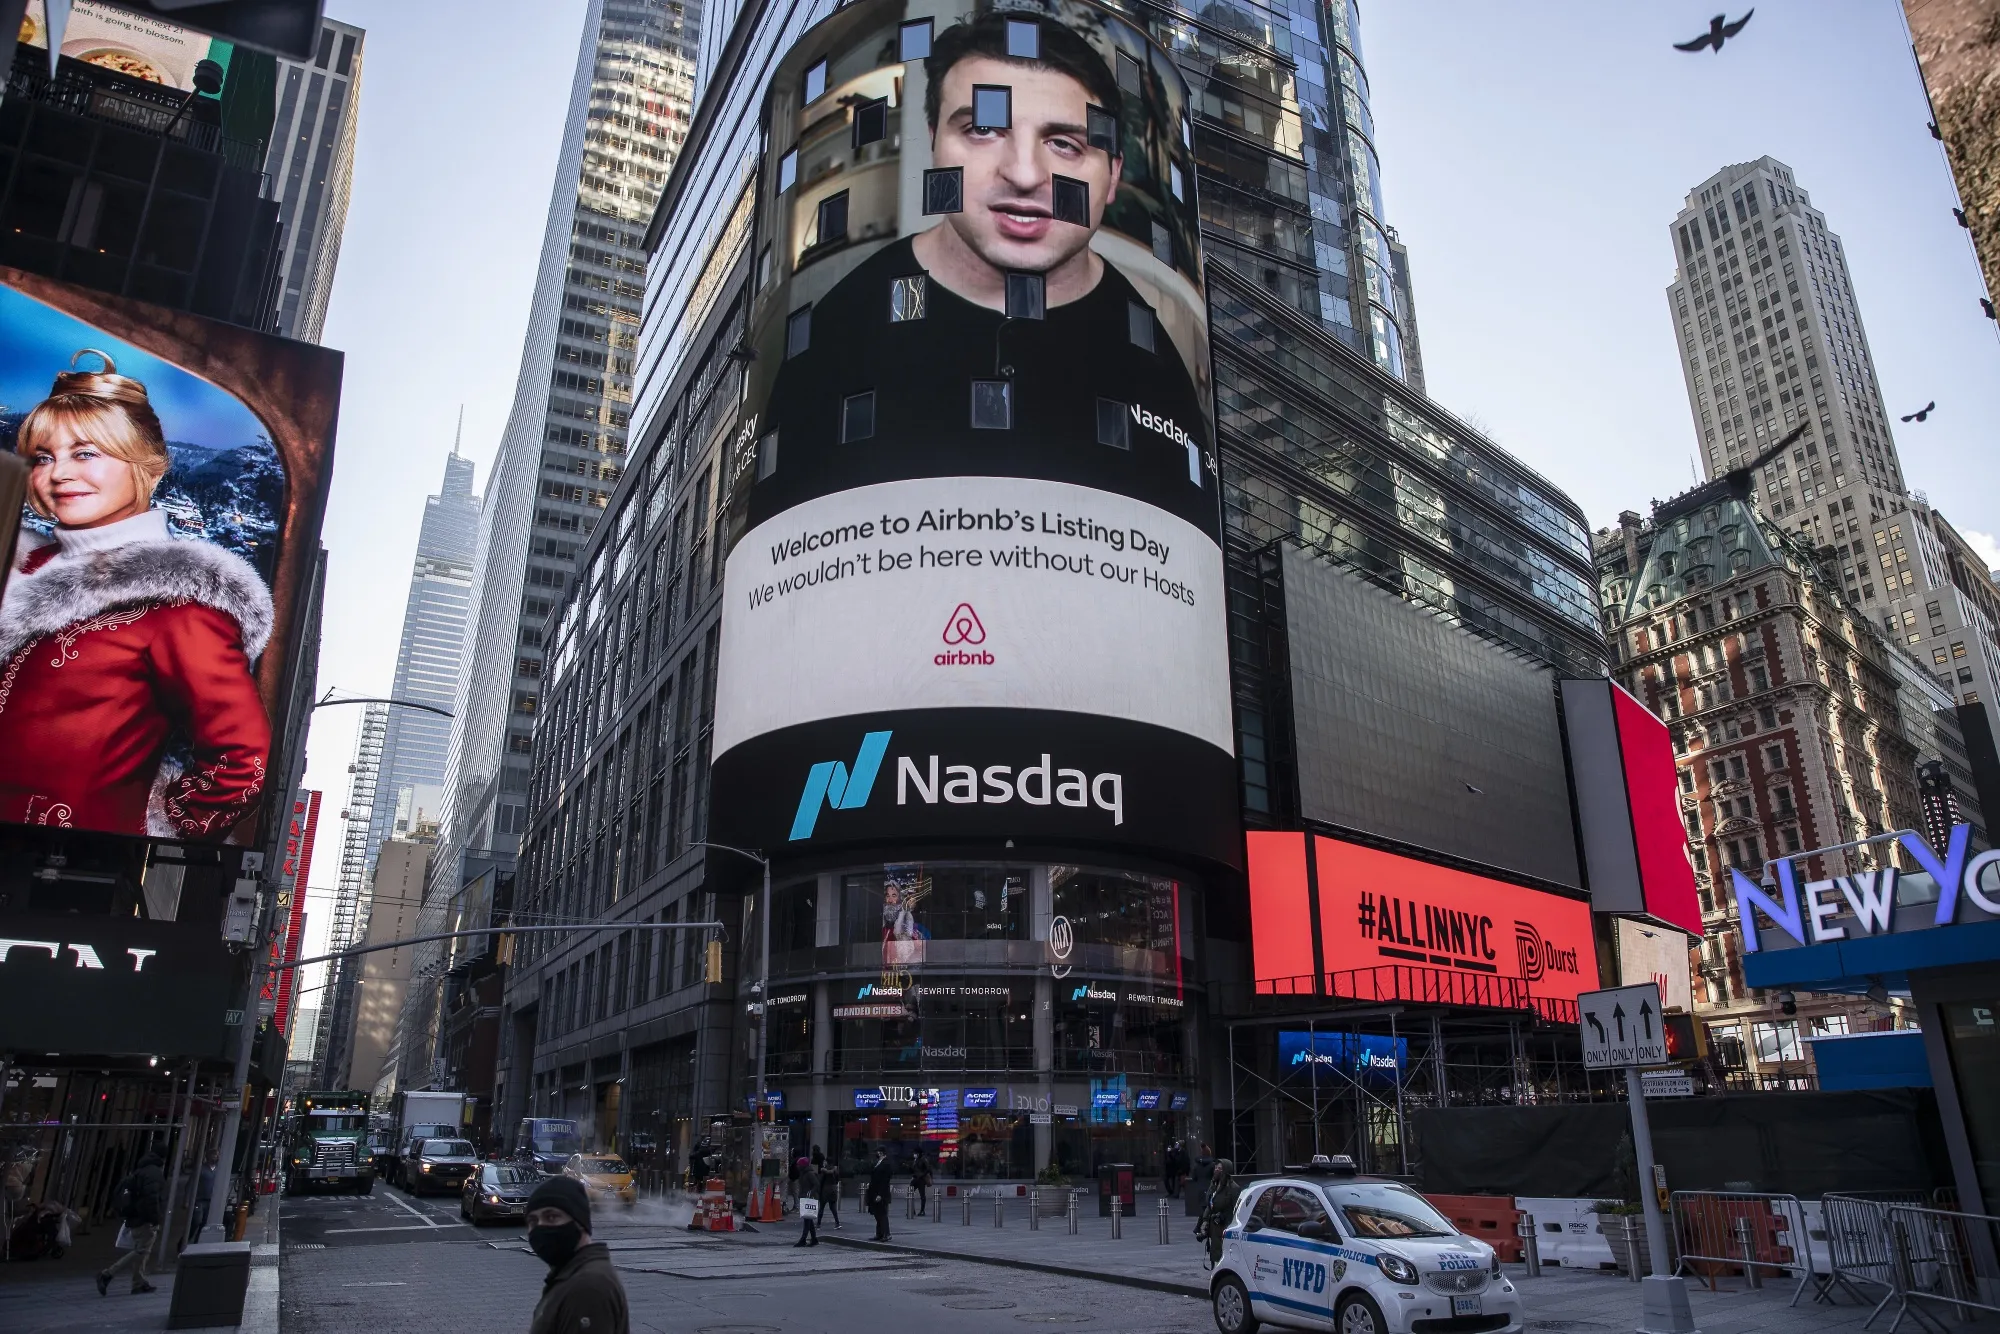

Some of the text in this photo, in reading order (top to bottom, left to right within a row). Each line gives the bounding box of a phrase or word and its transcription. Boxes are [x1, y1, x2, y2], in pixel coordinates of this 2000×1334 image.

[109, 6, 132, 18] Over
[134, 14, 149, 23] the
[151, 20, 171, 31] next
[104, 18, 132, 31] going
[134, 25, 143, 33] to
[145, 30, 186, 46] blossom.
[735, 413, 758, 457] esky
[771, 507, 1170, 565] Welcome to Airbnb’s Listing Day
[748, 545, 1195, 610] We wouldn’t be here without our Hosts
[934, 650, 995, 666] airbnb
[896, 753, 1124, 826] Nasdaq
[1731, 858, 1898, 952] NEW
[1358, 890, 1497, 960] #ALLINNYC
[1545, 940, 1579, 974] Durst
[777, 994, 807, 1005] TOMORROW
[872, 987, 1010, 997] Nasdaq REWRITE TOMORROW
[1087, 989, 1116, 1001] Nasdaq
[1128, 993, 1155, 1004] REWRITE
[833, 1006, 902, 1017] BRANDED CITIES
[921, 1045, 967, 1059] Nasdaq
[1586, 1049, 1608, 1063] ONLY
[1611, 1047, 1634, 1061] ONLY
[1638, 1045, 1662, 1059] ONLY
[1338, 1247, 1367, 1263] POLICE
[1437, 1252, 1469, 1260] NYPD
[1438, 1259, 1479, 1270] POLICE
[1282, 1257, 1326, 1294] NYPD
